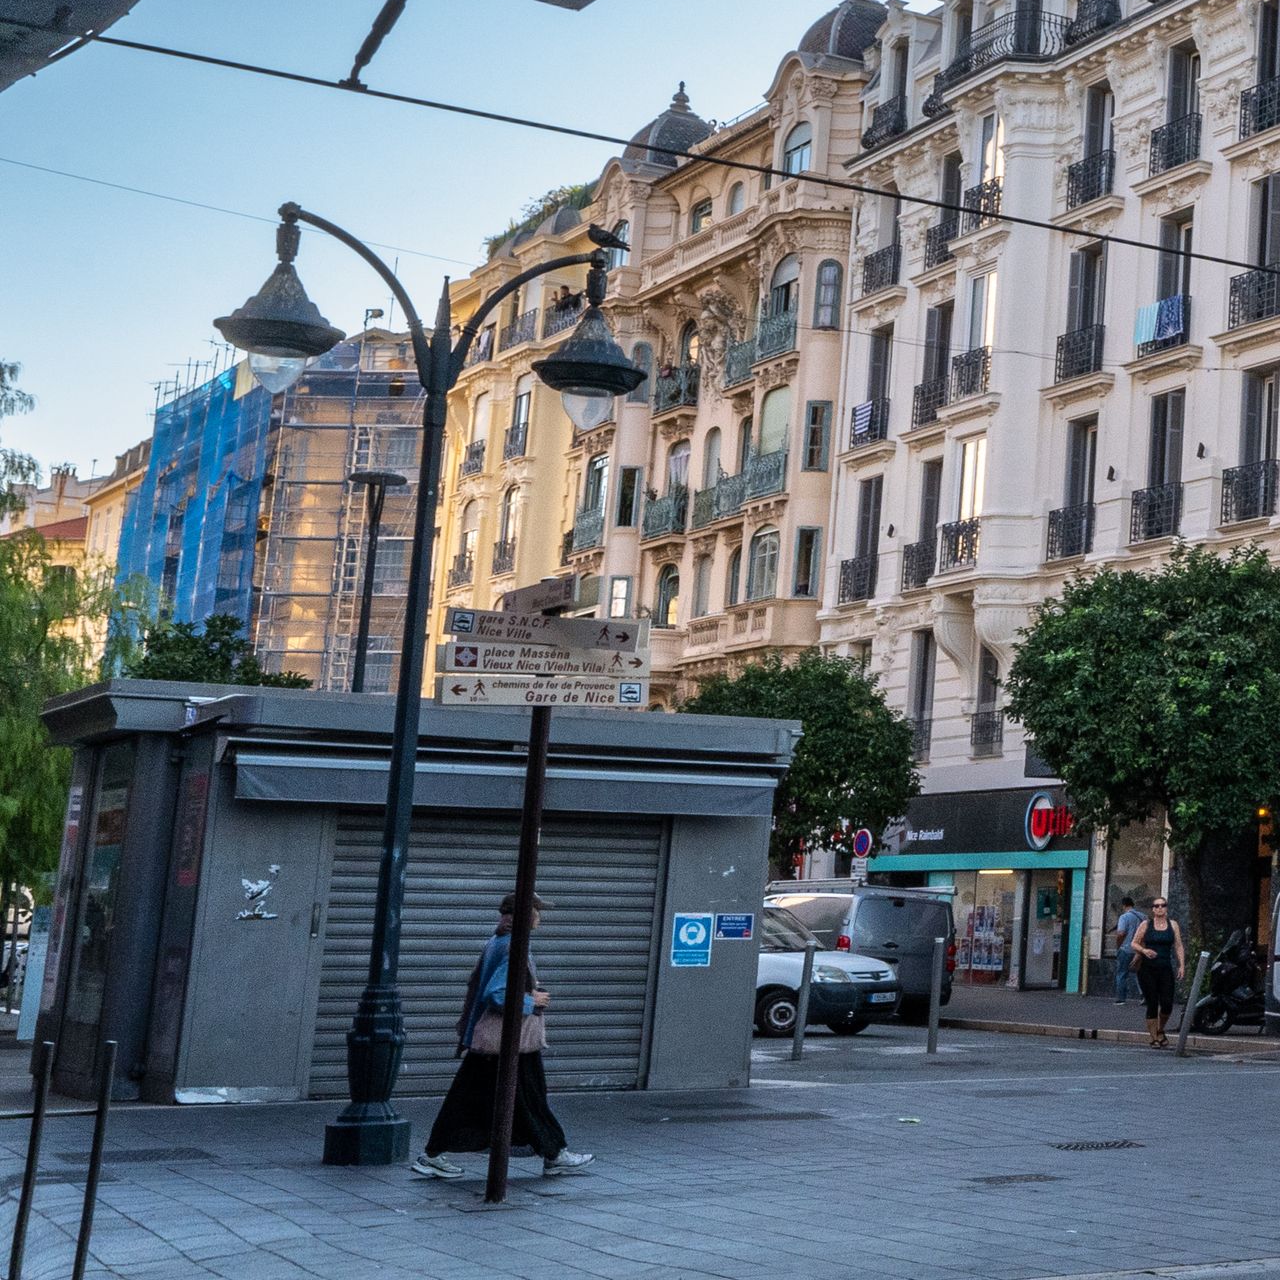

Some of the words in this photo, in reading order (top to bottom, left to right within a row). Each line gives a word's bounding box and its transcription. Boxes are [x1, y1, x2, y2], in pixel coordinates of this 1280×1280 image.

[479, 615, 505, 625] gare
[477, 625, 502, 636] Nice
[506, 628, 532, 639] Ville
[483, 646, 515, 660] place
[520, 647, 571, 659] Masséna
[483, 659, 513, 670] Vieux
[516, 660, 541, 671] Nice
[492, 680, 530, 689] chemins
[532, 681, 544, 689] de
[546, 681, 559, 689] fer
[561, 681, 572, 690] de
[574, 681, 616, 690] Provence
[525, 691, 558, 702] Gare
[563, 692, 579, 703] de
[585, 692, 615, 703] Nice
[906, 831, 918, 840] Nice
